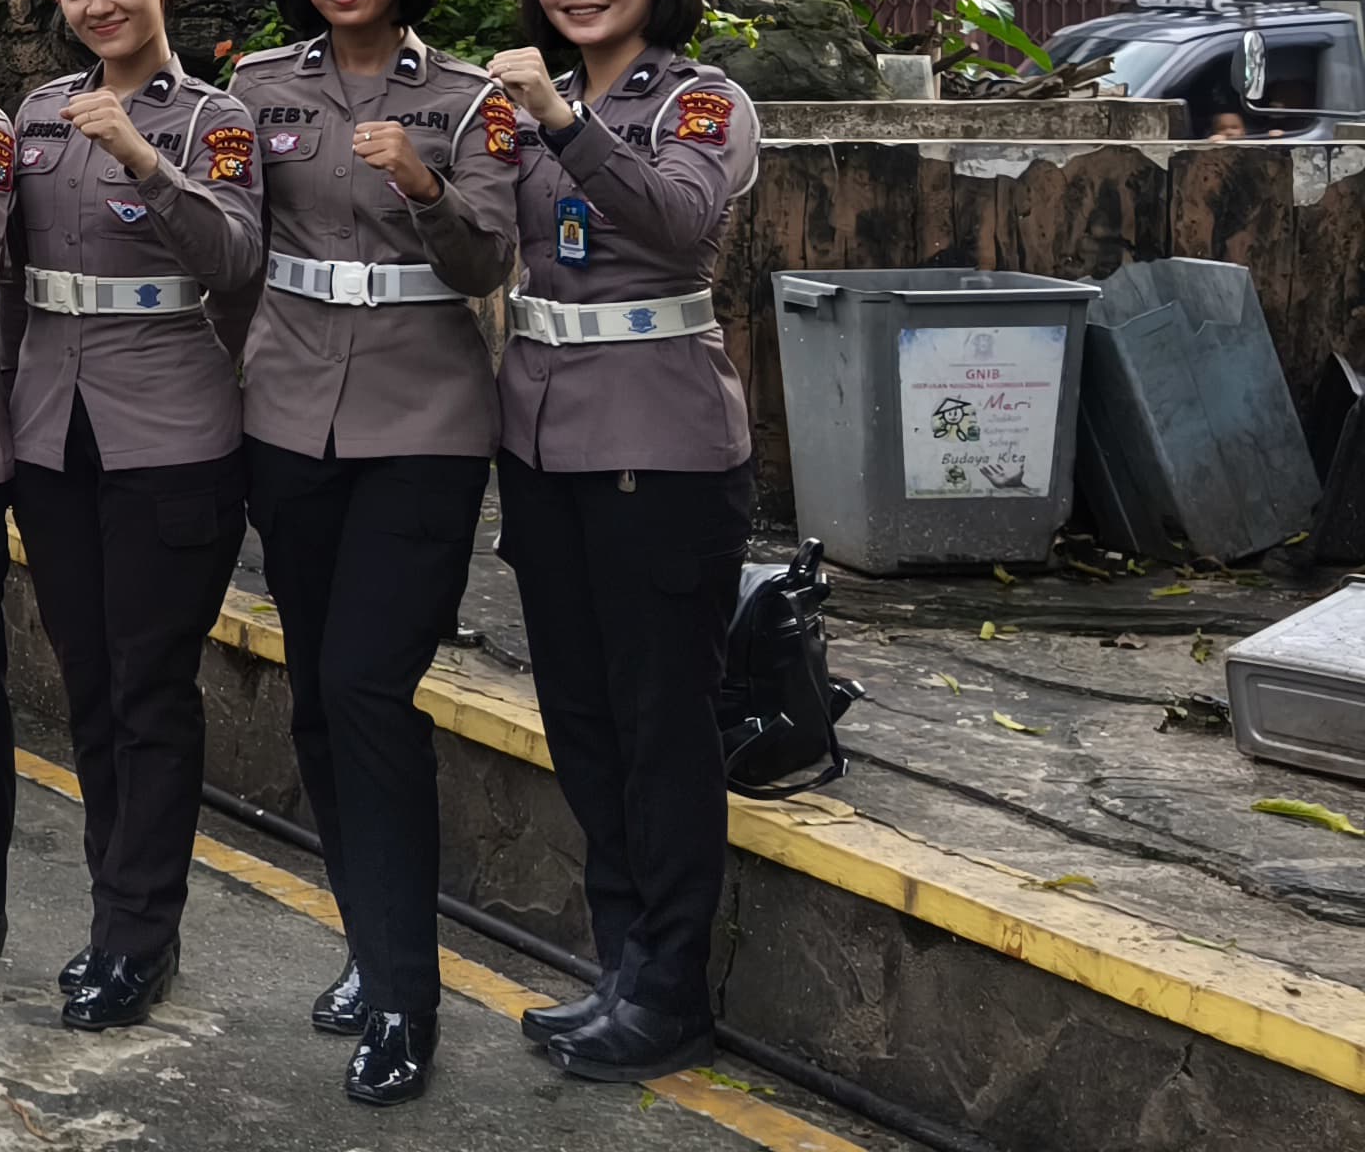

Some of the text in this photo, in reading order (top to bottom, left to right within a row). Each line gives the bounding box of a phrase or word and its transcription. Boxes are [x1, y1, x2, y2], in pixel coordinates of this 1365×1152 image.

[485, 96, 515, 111] OLDA
[682, 92, 730, 107] POLDA
[258, 106, 320, 126] FEBY
[208, 127, 251, 145] POLDA
[965, 368, 1001, 380] GNIB
[983, 392, 1032, 411] Mari
[942, 451, 1027, 467] Budaya Kita
